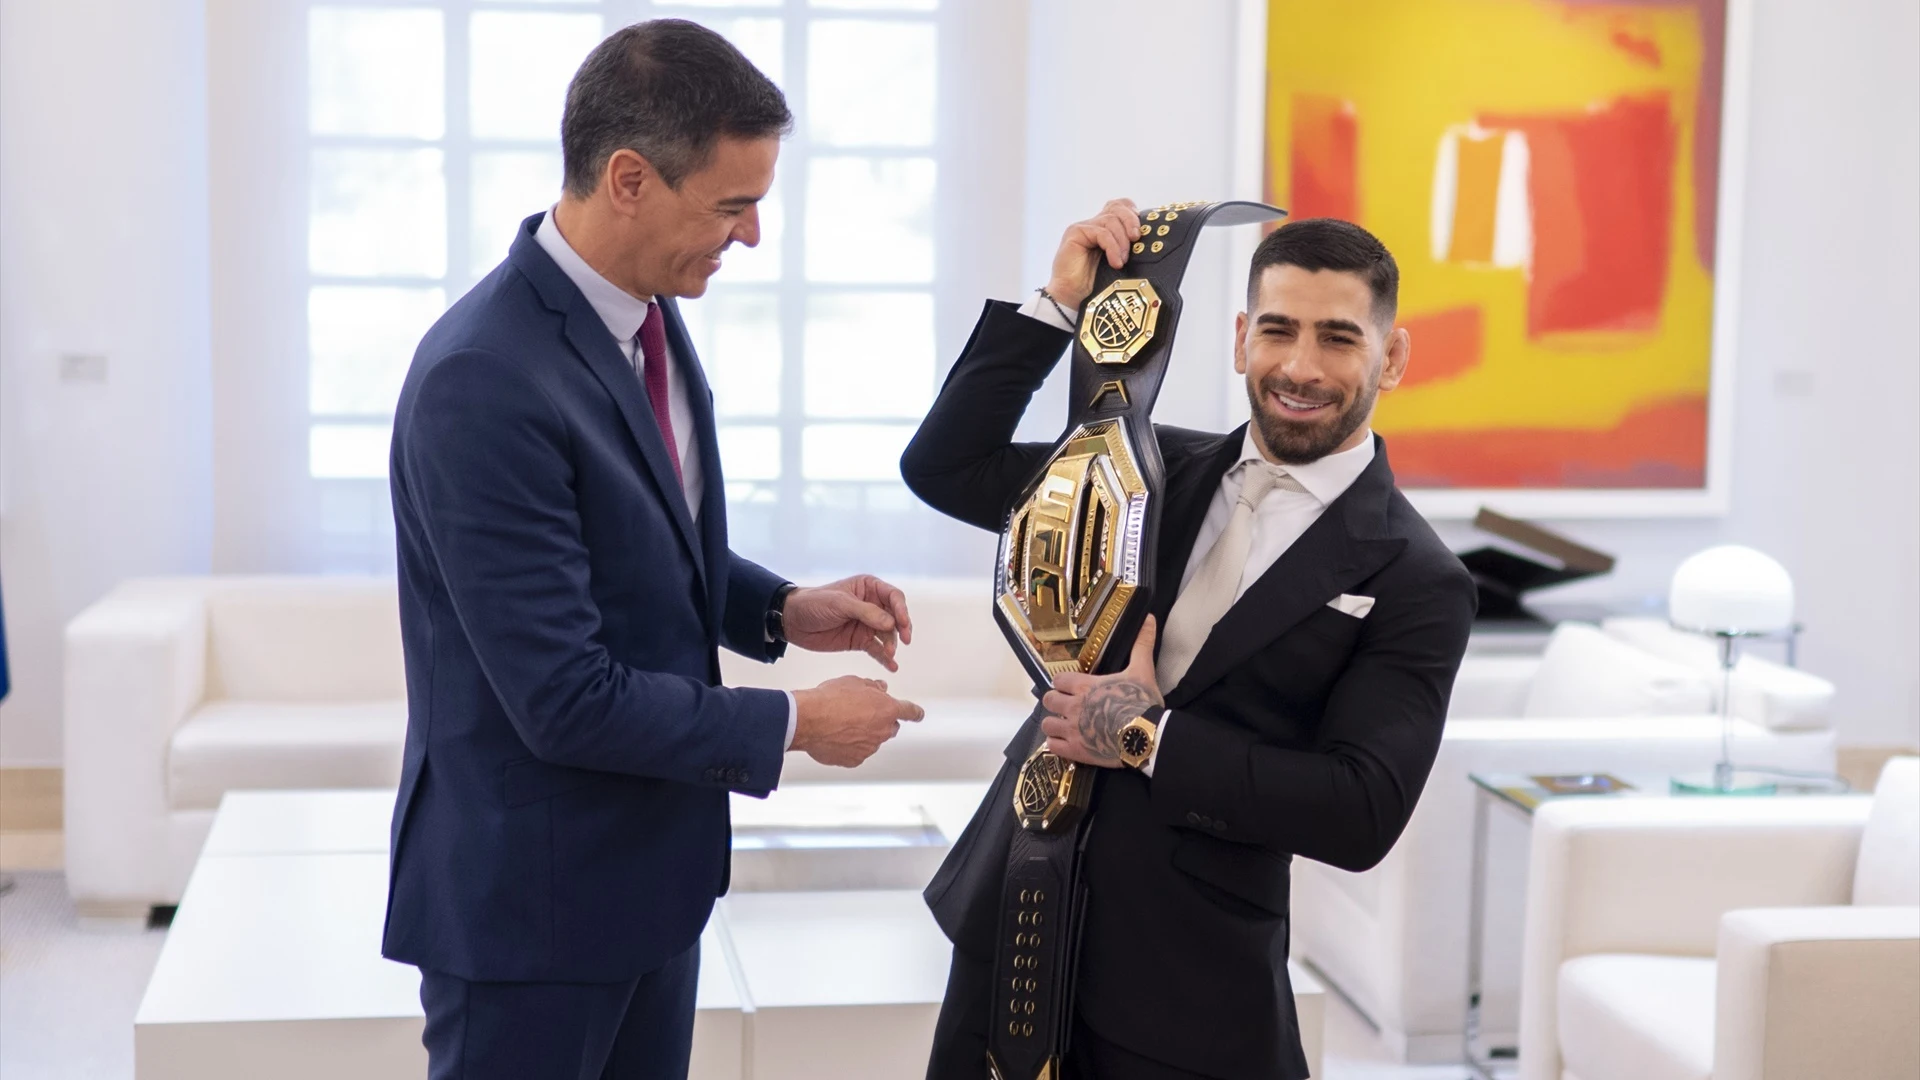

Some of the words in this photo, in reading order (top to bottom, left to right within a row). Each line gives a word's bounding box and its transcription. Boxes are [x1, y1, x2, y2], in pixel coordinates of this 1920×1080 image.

[1103, 300, 1132, 341] CHAMPION
[1112, 299, 1136, 332] WORLD
[1126, 295, 1142, 314] UFC
[1031, 474, 1077, 615] UFC
